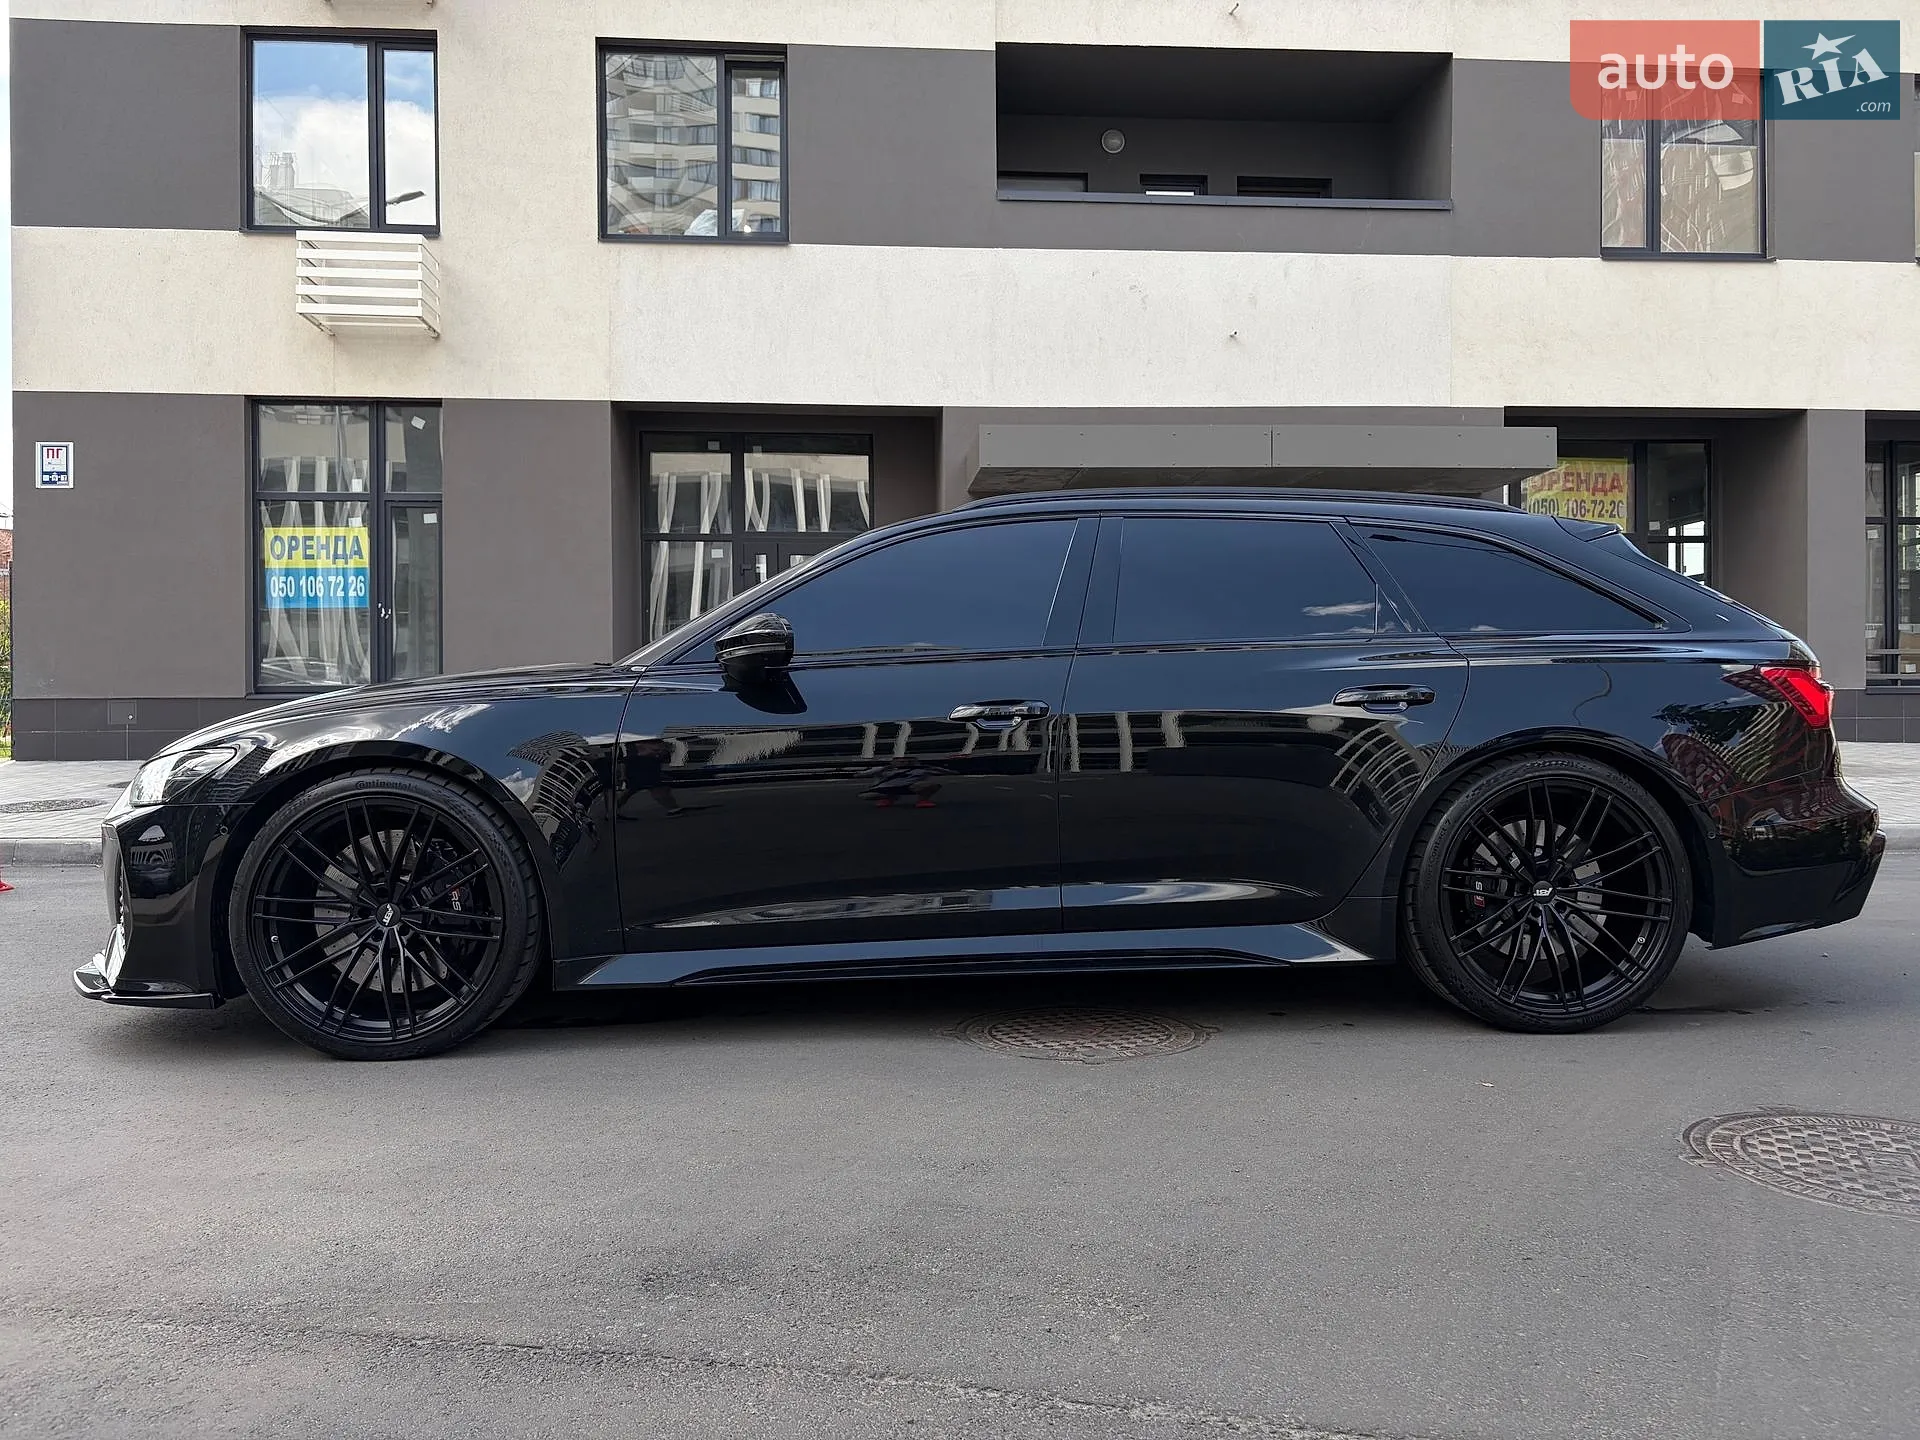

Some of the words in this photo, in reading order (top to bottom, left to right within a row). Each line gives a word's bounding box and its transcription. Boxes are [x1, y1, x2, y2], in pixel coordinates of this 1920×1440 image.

[46, 448, 63, 459] ПГ
[1529, 498, 1559, 516] (050)
[270, 535, 364, 565] ОРЕНДА
[270, 576, 295, 597] 050
[300, 576, 324, 597] 106
[328, 576, 344, 597] 72
[348, 576, 365, 597] 26
